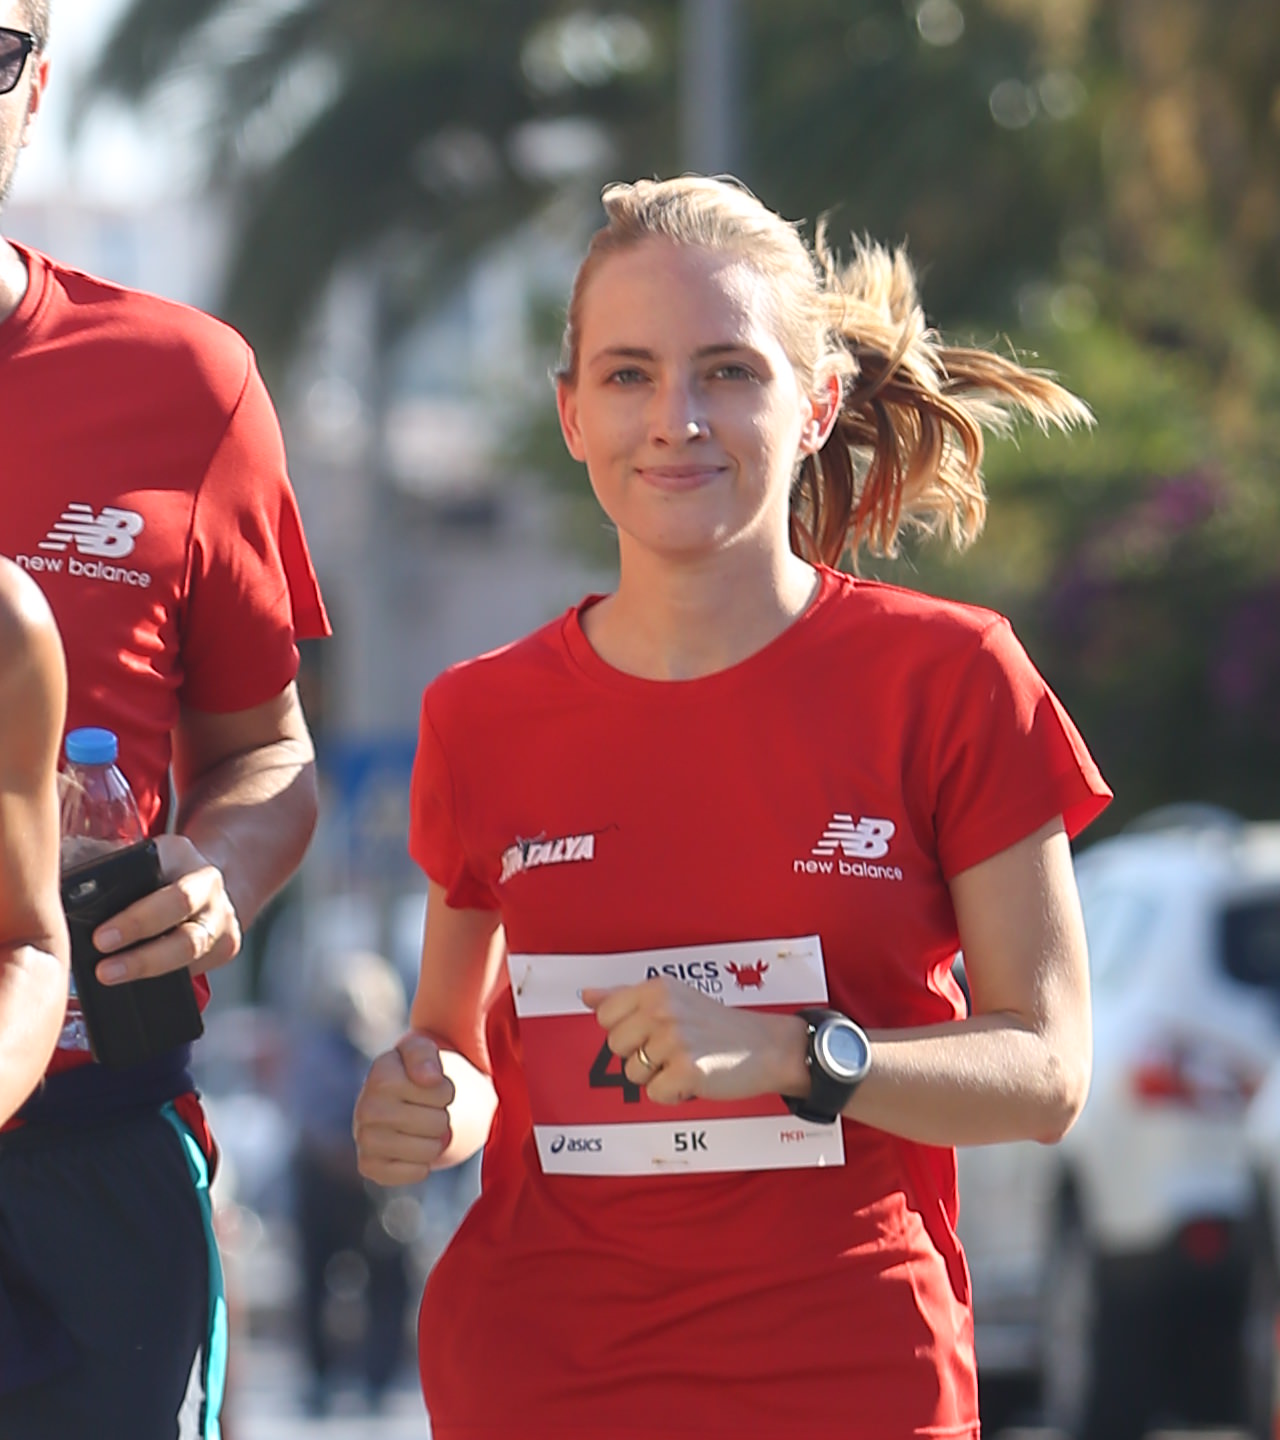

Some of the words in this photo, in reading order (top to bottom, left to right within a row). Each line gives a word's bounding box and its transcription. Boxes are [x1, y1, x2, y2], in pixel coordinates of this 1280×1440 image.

[16, 555, 63, 572] new
[68, 557, 151, 588] balance
[793, 859, 833, 874] new
[839, 859, 903, 880] balance
[567, 1137, 603, 1152] asics
[673, 1131, 708, 1152] 5K
